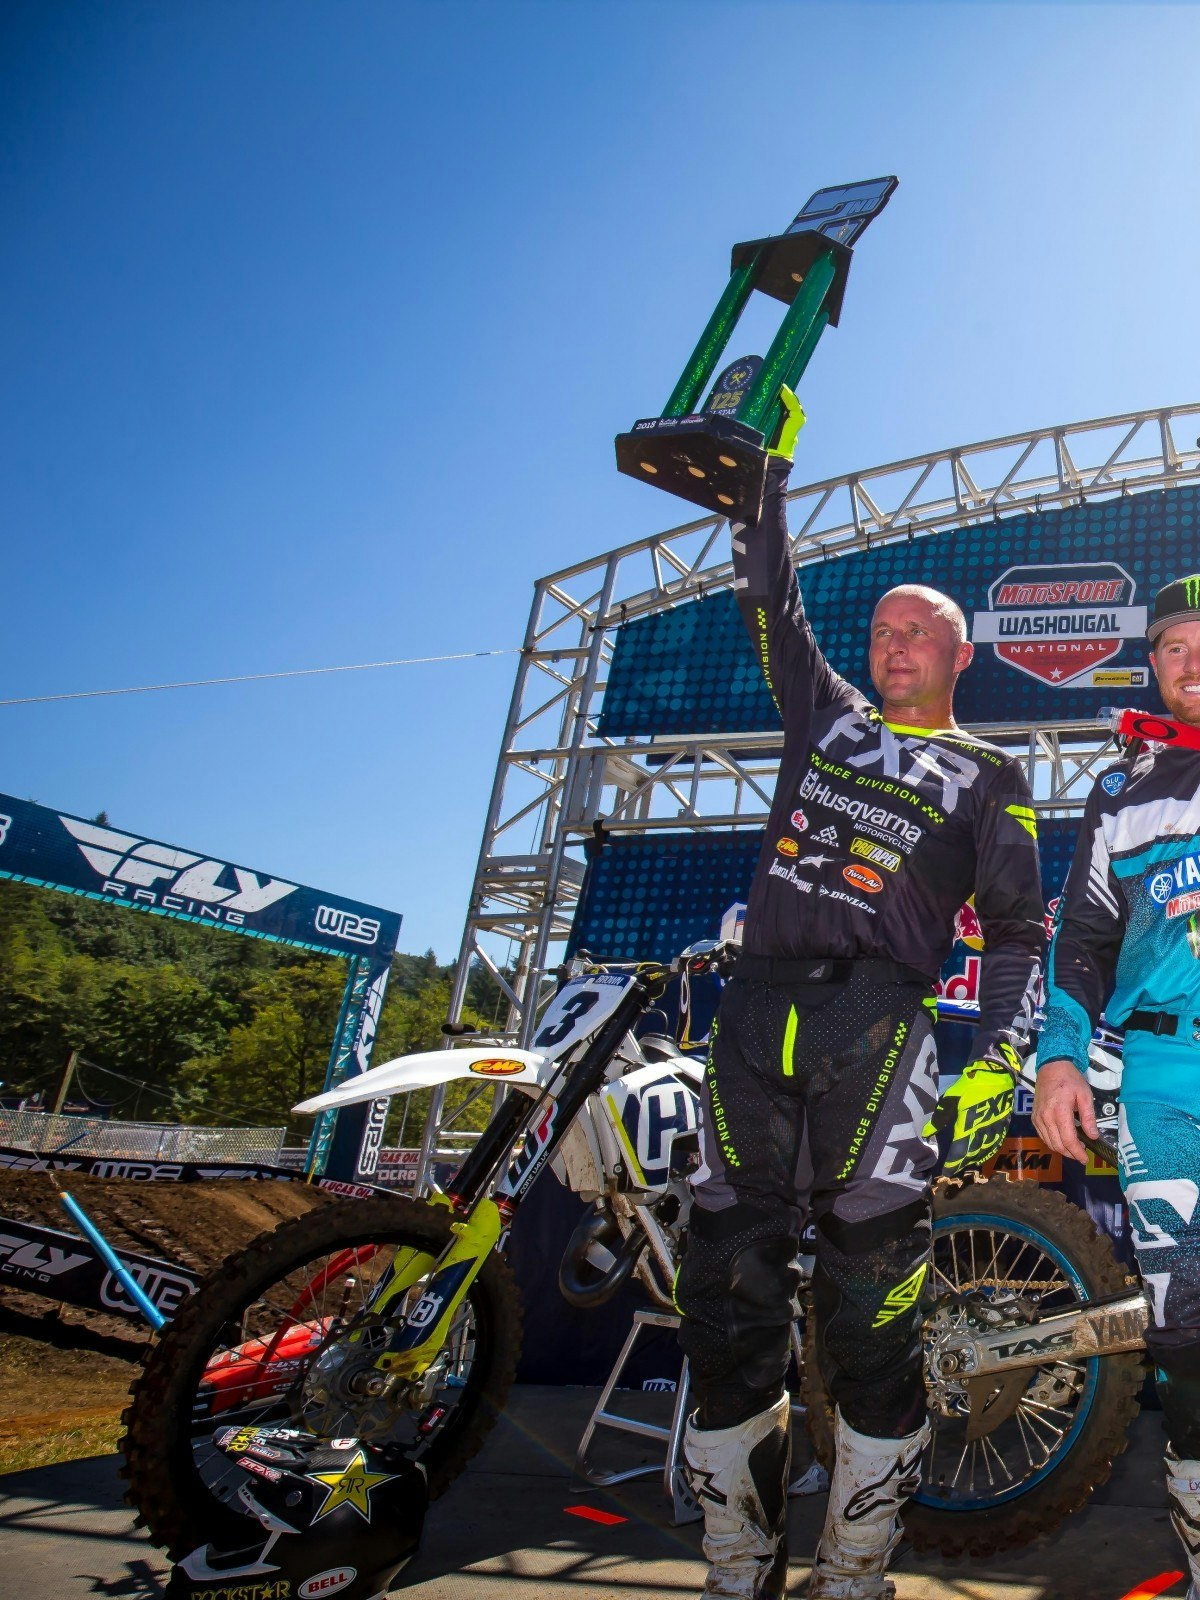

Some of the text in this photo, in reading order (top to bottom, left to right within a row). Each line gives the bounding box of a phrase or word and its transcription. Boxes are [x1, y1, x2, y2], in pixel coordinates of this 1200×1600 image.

[711, 390, 743, 410] 125
[636, 420, 657, 430] 2018
[999, 613, 1120, 635] WASHOUGAL
[1010, 643, 1106, 653] NATIONAL
[981, 752, 1002, 767] RIDE
[821, 763, 921, 806] RACE DIVISION
[810, 782, 922, 843] Husqvarna
[853, 823, 913, 855] MOTORCYCLES
[847, 869, 881, 889] Twin Air
[102, 881, 245, 925] RACING
[829, 890, 877, 915] DUNLOP
[534, 990, 600, 1048] 3
[472, 1060, 523, 1075] FMF
[709, 1080, 730, 1141] DIVISION
[850, 1048, 899, 1157] RACE DIVISION
[321, 1179, 374, 1199] LUCAS OIL
[988, 1329, 1075, 1362] TAG
[308, 1572, 349, 1594] BELL
